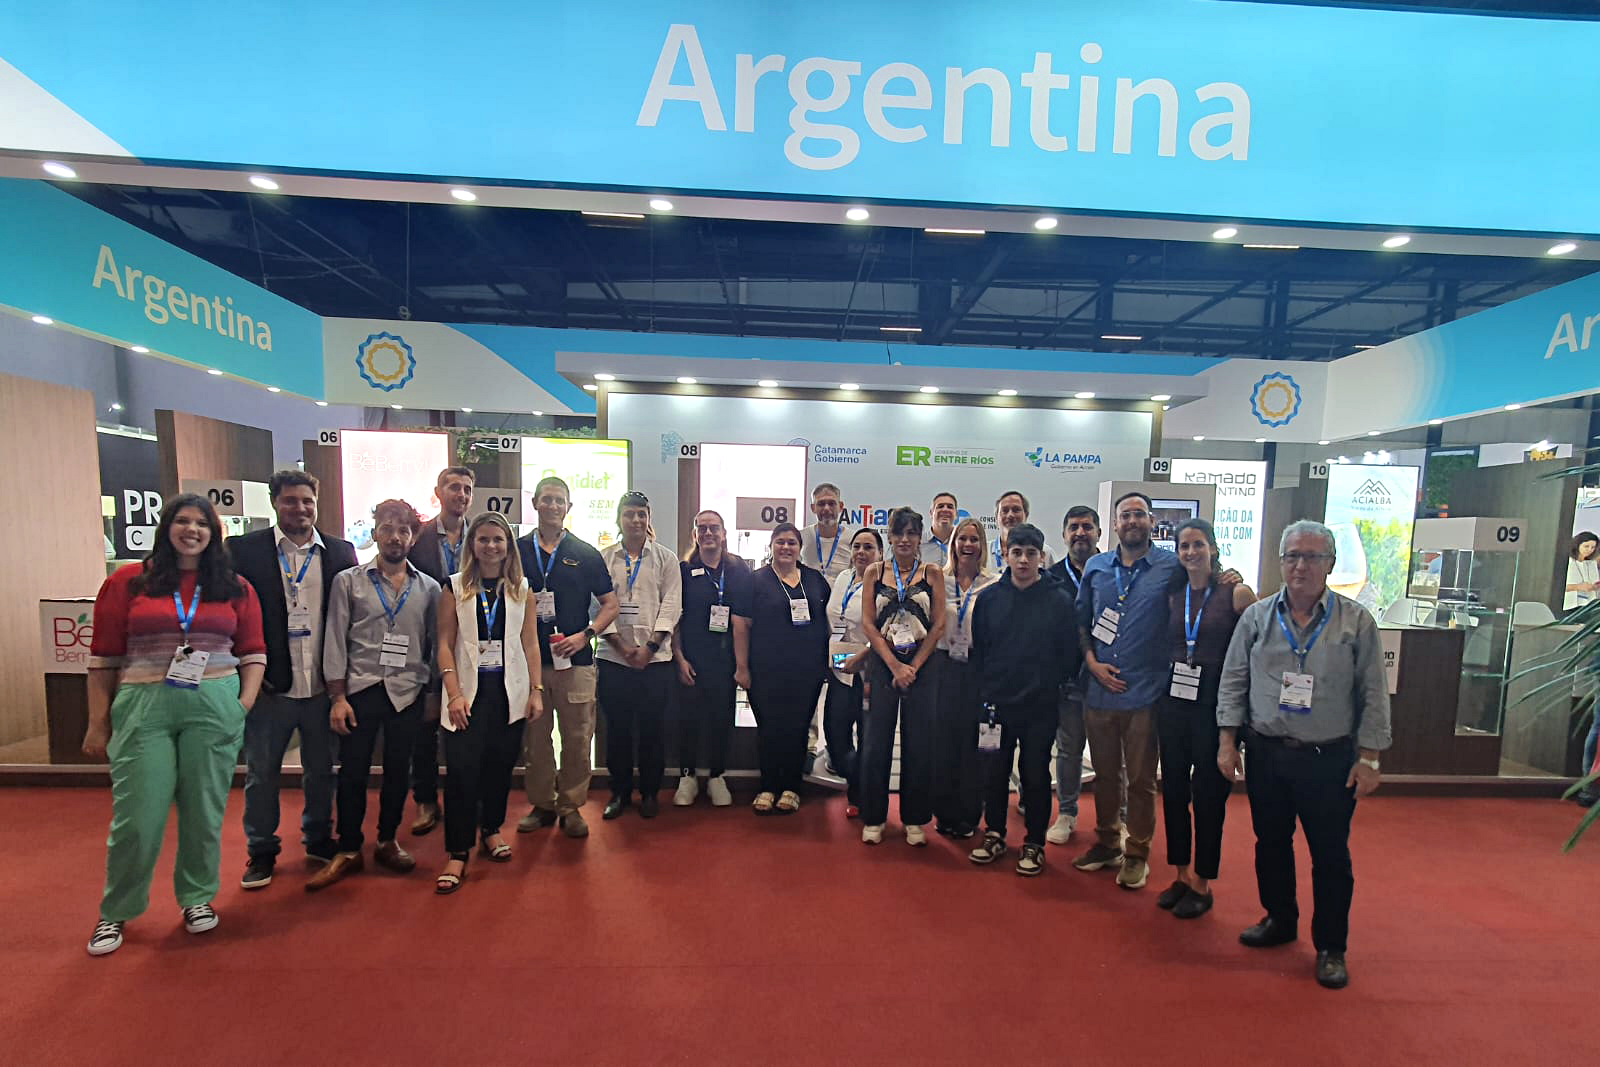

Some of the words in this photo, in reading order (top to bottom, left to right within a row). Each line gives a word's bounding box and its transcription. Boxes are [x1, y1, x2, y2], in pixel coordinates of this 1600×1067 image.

[636, 23, 1251, 170] Argentina
[92, 244, 272, 352] Argentina
[1544, 312, 1600, 360] Ar
[320, 431, 338, 443] 06
[501, 437, 519, 449] 07
[681, 444, 698, 456] 08
[814, 444, 867, 455] Catamarca
[814, 454, 860, 464] Gobierno
[896, 446, 931, 467] ER
[934, 455, 968, 464] ENTRE
[970, 455, 994, 465] RÍOS
[1045, 453, 1060, 463] LA
[1063, 453, 1102, 464] PAMPA
[1153, 461, 1169, 471] 09
[1312, 465, 1327, 476] 10
[208, 489, 235, 507] 06
[1218, 487, 1256, 496] NTINO
[124, 490, 163, 524] PR
[487, 497, 514, 516] 07
[761, 506, 788, 524] 08
[131, 530, 143, 546] C
[1233, 526, 1252, 540] COM
[1497, 526, 1520, 542] 09
[1219, 543, 1232, 556] AS
